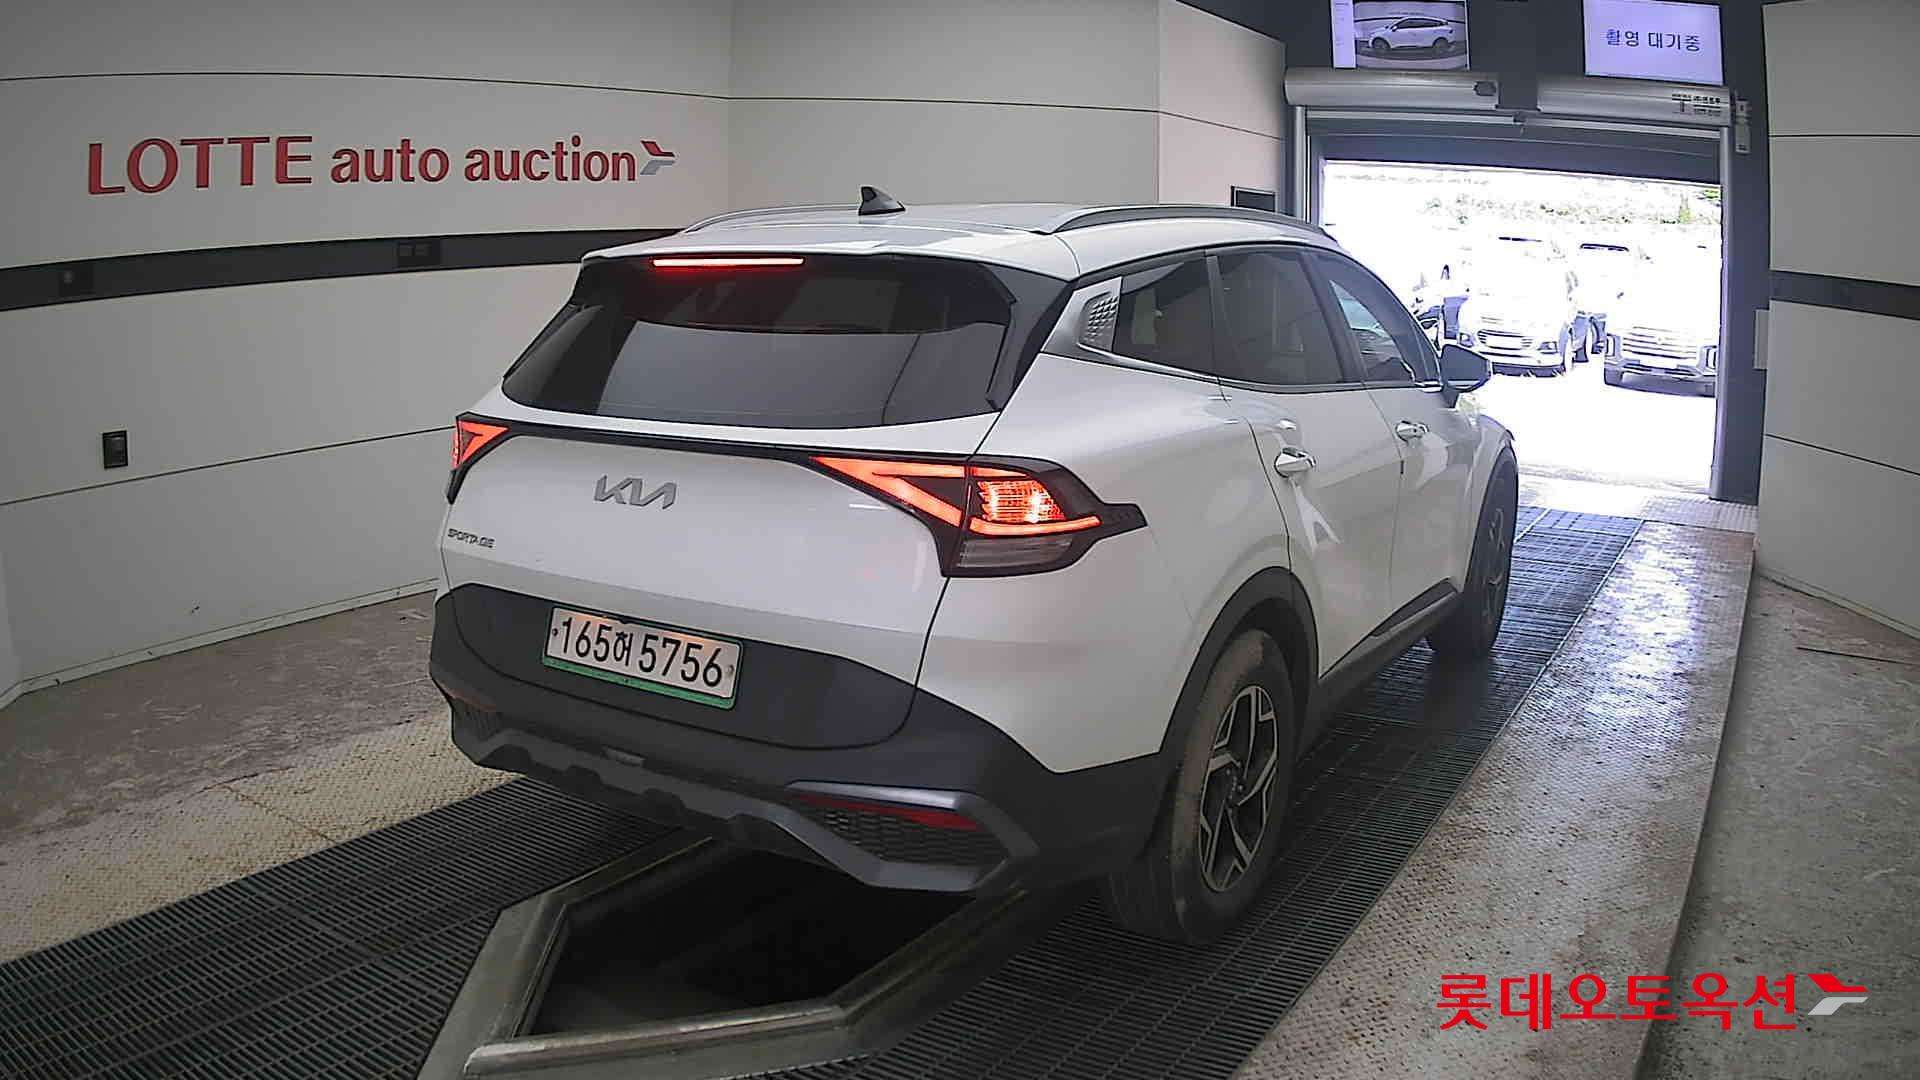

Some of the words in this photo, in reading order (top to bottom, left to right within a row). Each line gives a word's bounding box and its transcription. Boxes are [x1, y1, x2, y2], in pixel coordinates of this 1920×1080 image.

[1648, 32, 1701, 52] 대기중
[88, 135, 313, 195] LOTTE
[330, 138, 450, 183] auto
[463, 134, 636, 183] auction
